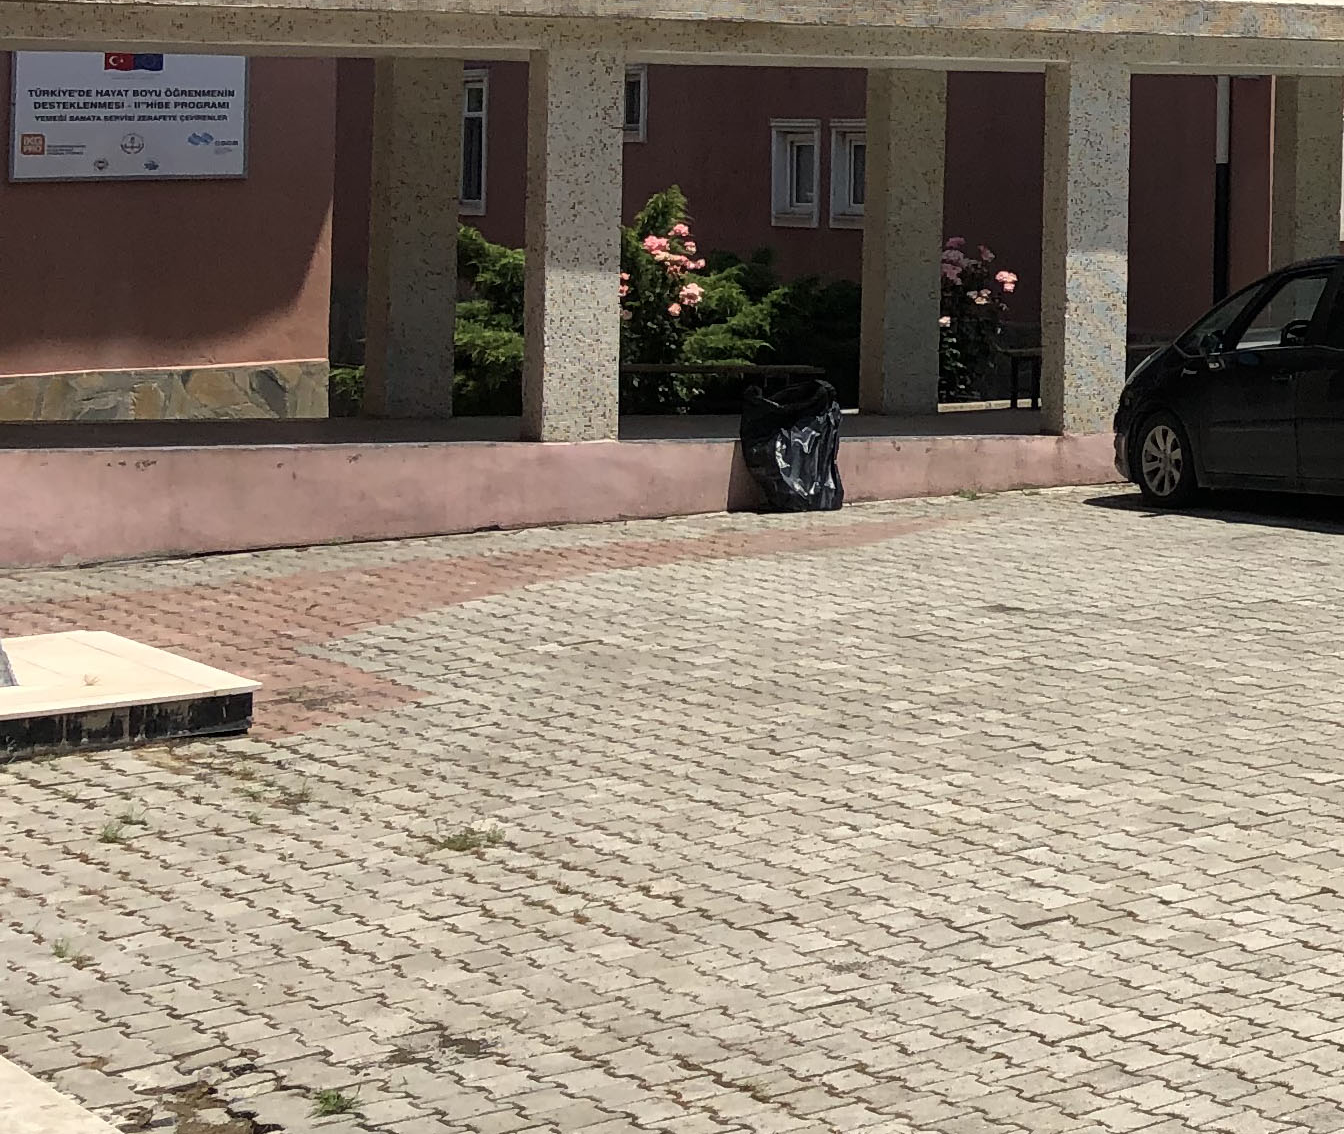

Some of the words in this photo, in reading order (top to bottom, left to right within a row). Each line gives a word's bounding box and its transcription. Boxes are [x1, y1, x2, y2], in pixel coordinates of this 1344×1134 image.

[95, 89, 130, 98] HAYAT
[132, 89, 162, 98] BOYU
[164, 87, 236, 98] ÖĞRENMENİN
[173, 101, 230, 110] PROGRAMI
